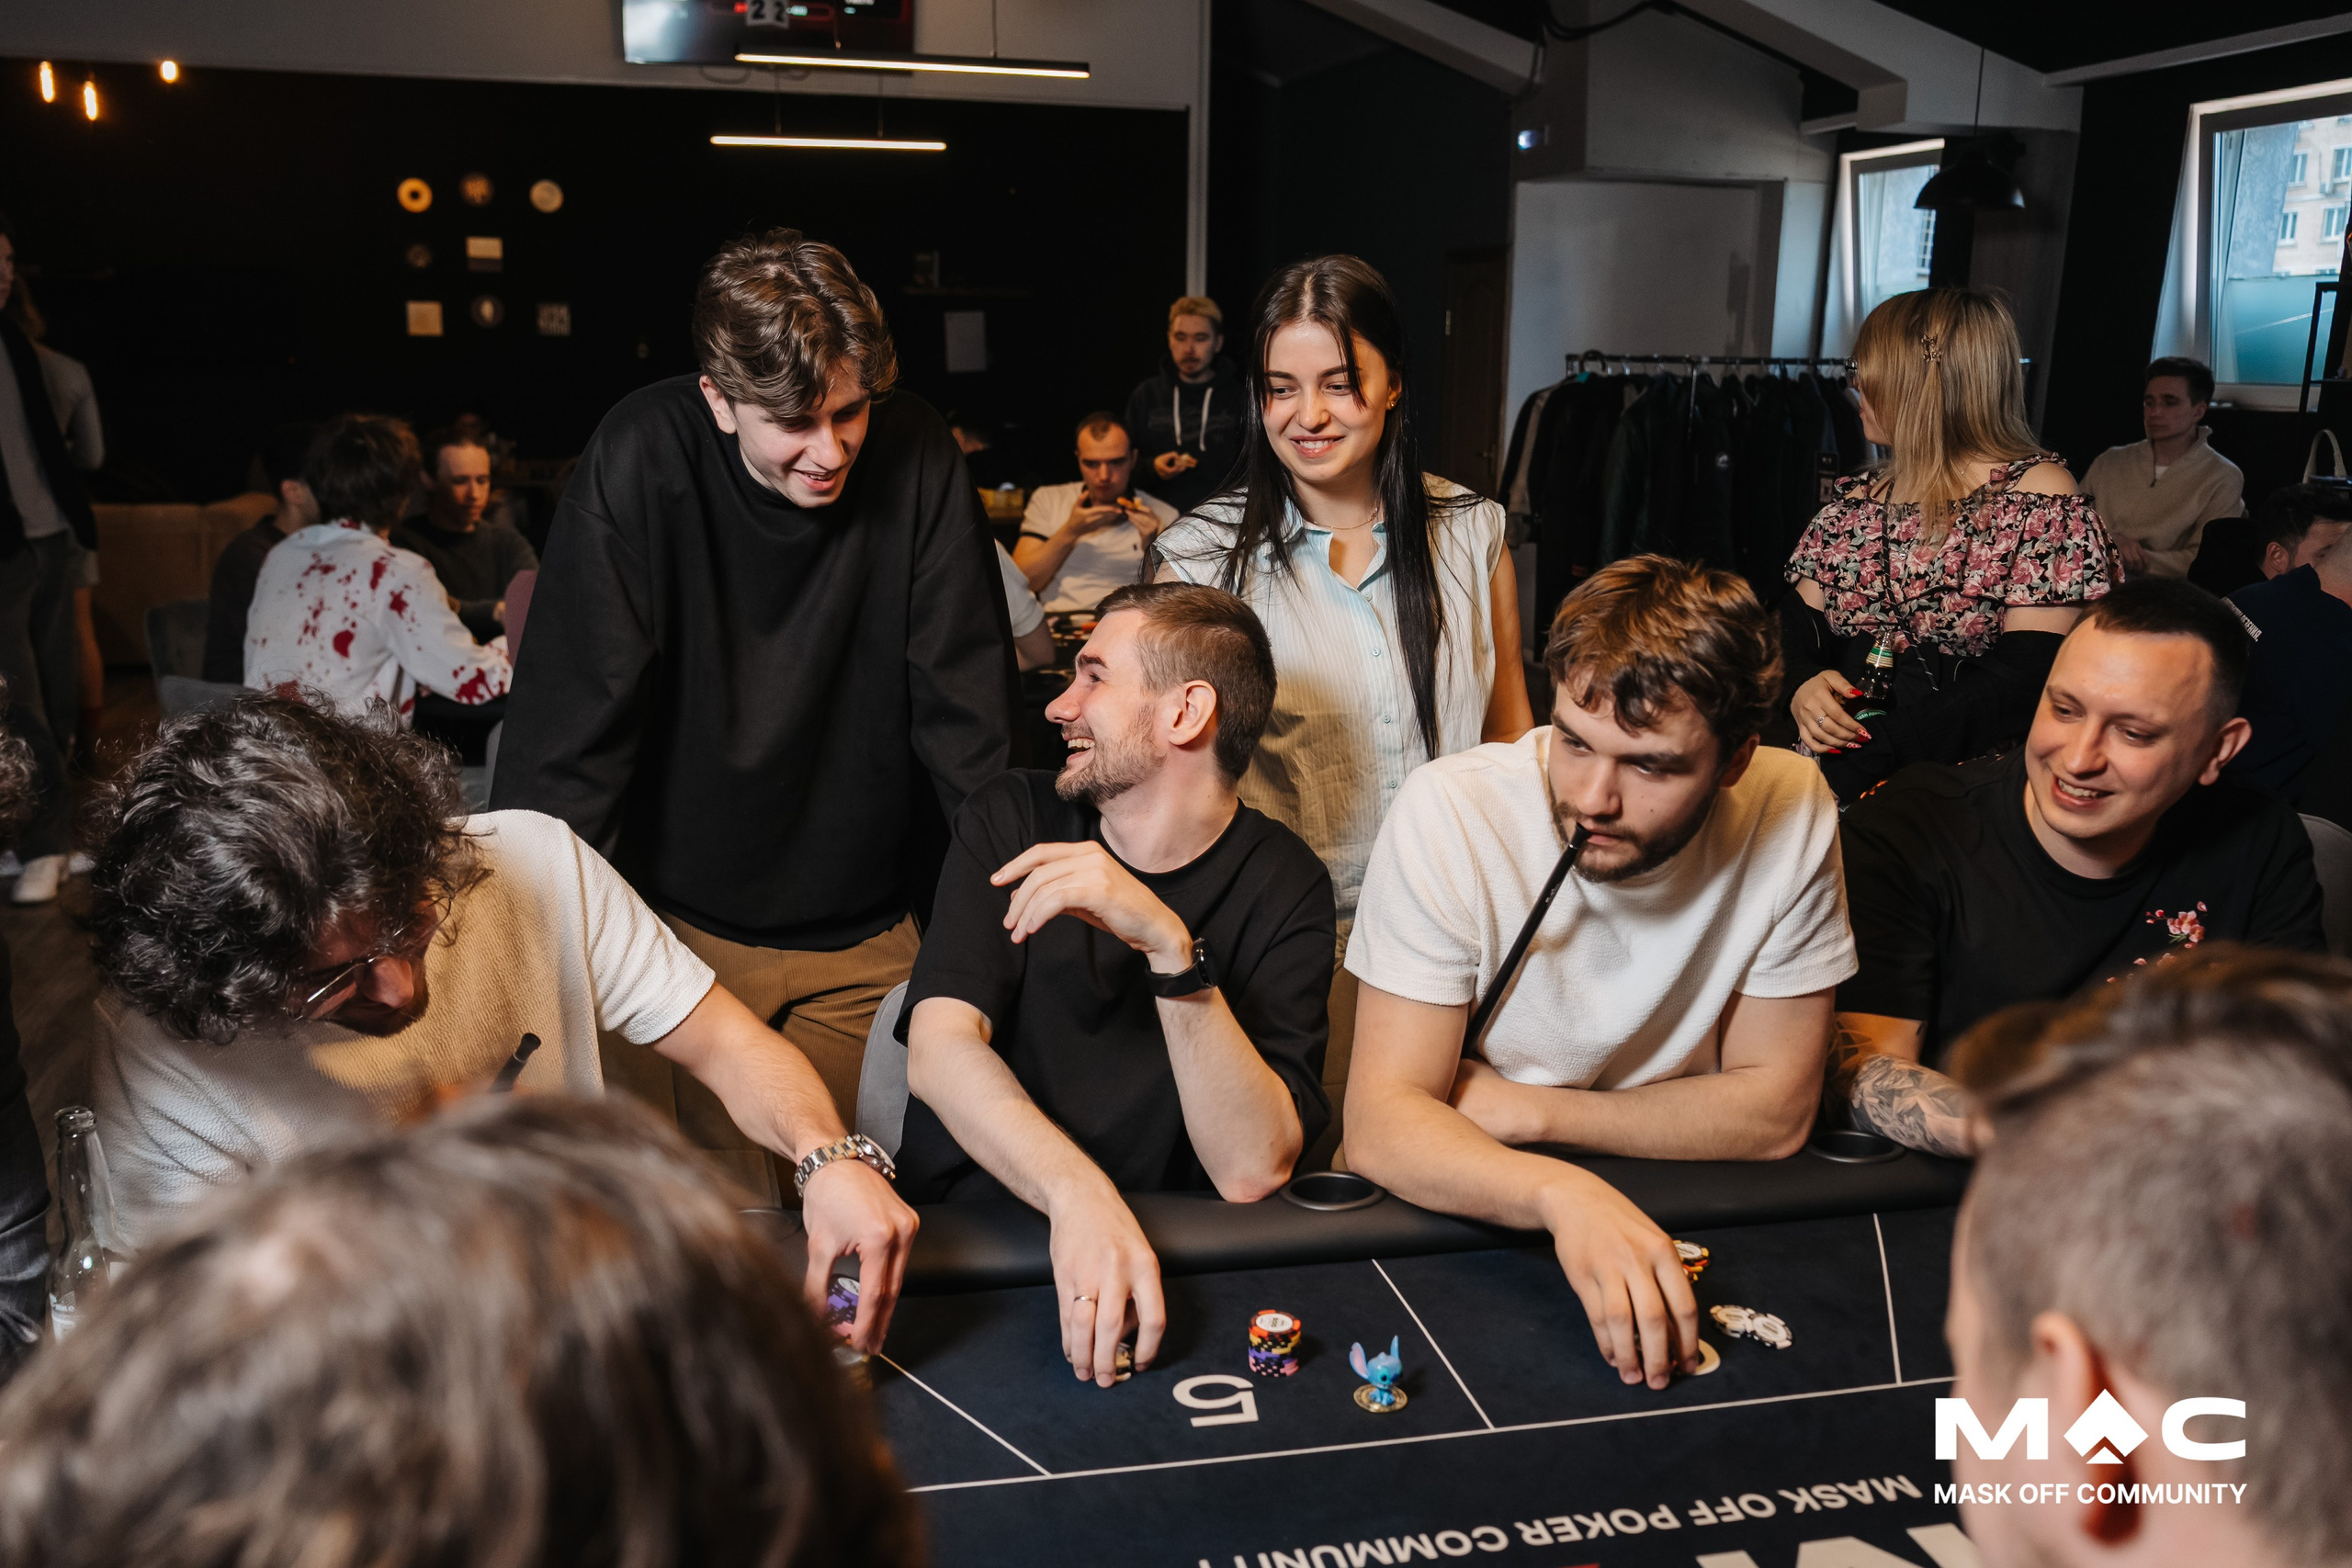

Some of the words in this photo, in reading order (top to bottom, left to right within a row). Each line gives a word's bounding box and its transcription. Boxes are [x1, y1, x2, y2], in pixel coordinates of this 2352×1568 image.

[1172, 1374, 1259, 1427] 5
[1688, 1493, 1777, 1527] OFF
[1778, 1474, 1923, 1514] MASK
[1513, 1504, 1682, 1547] POKER
[1198, 1526, 1510, 1568] COMMUNI
